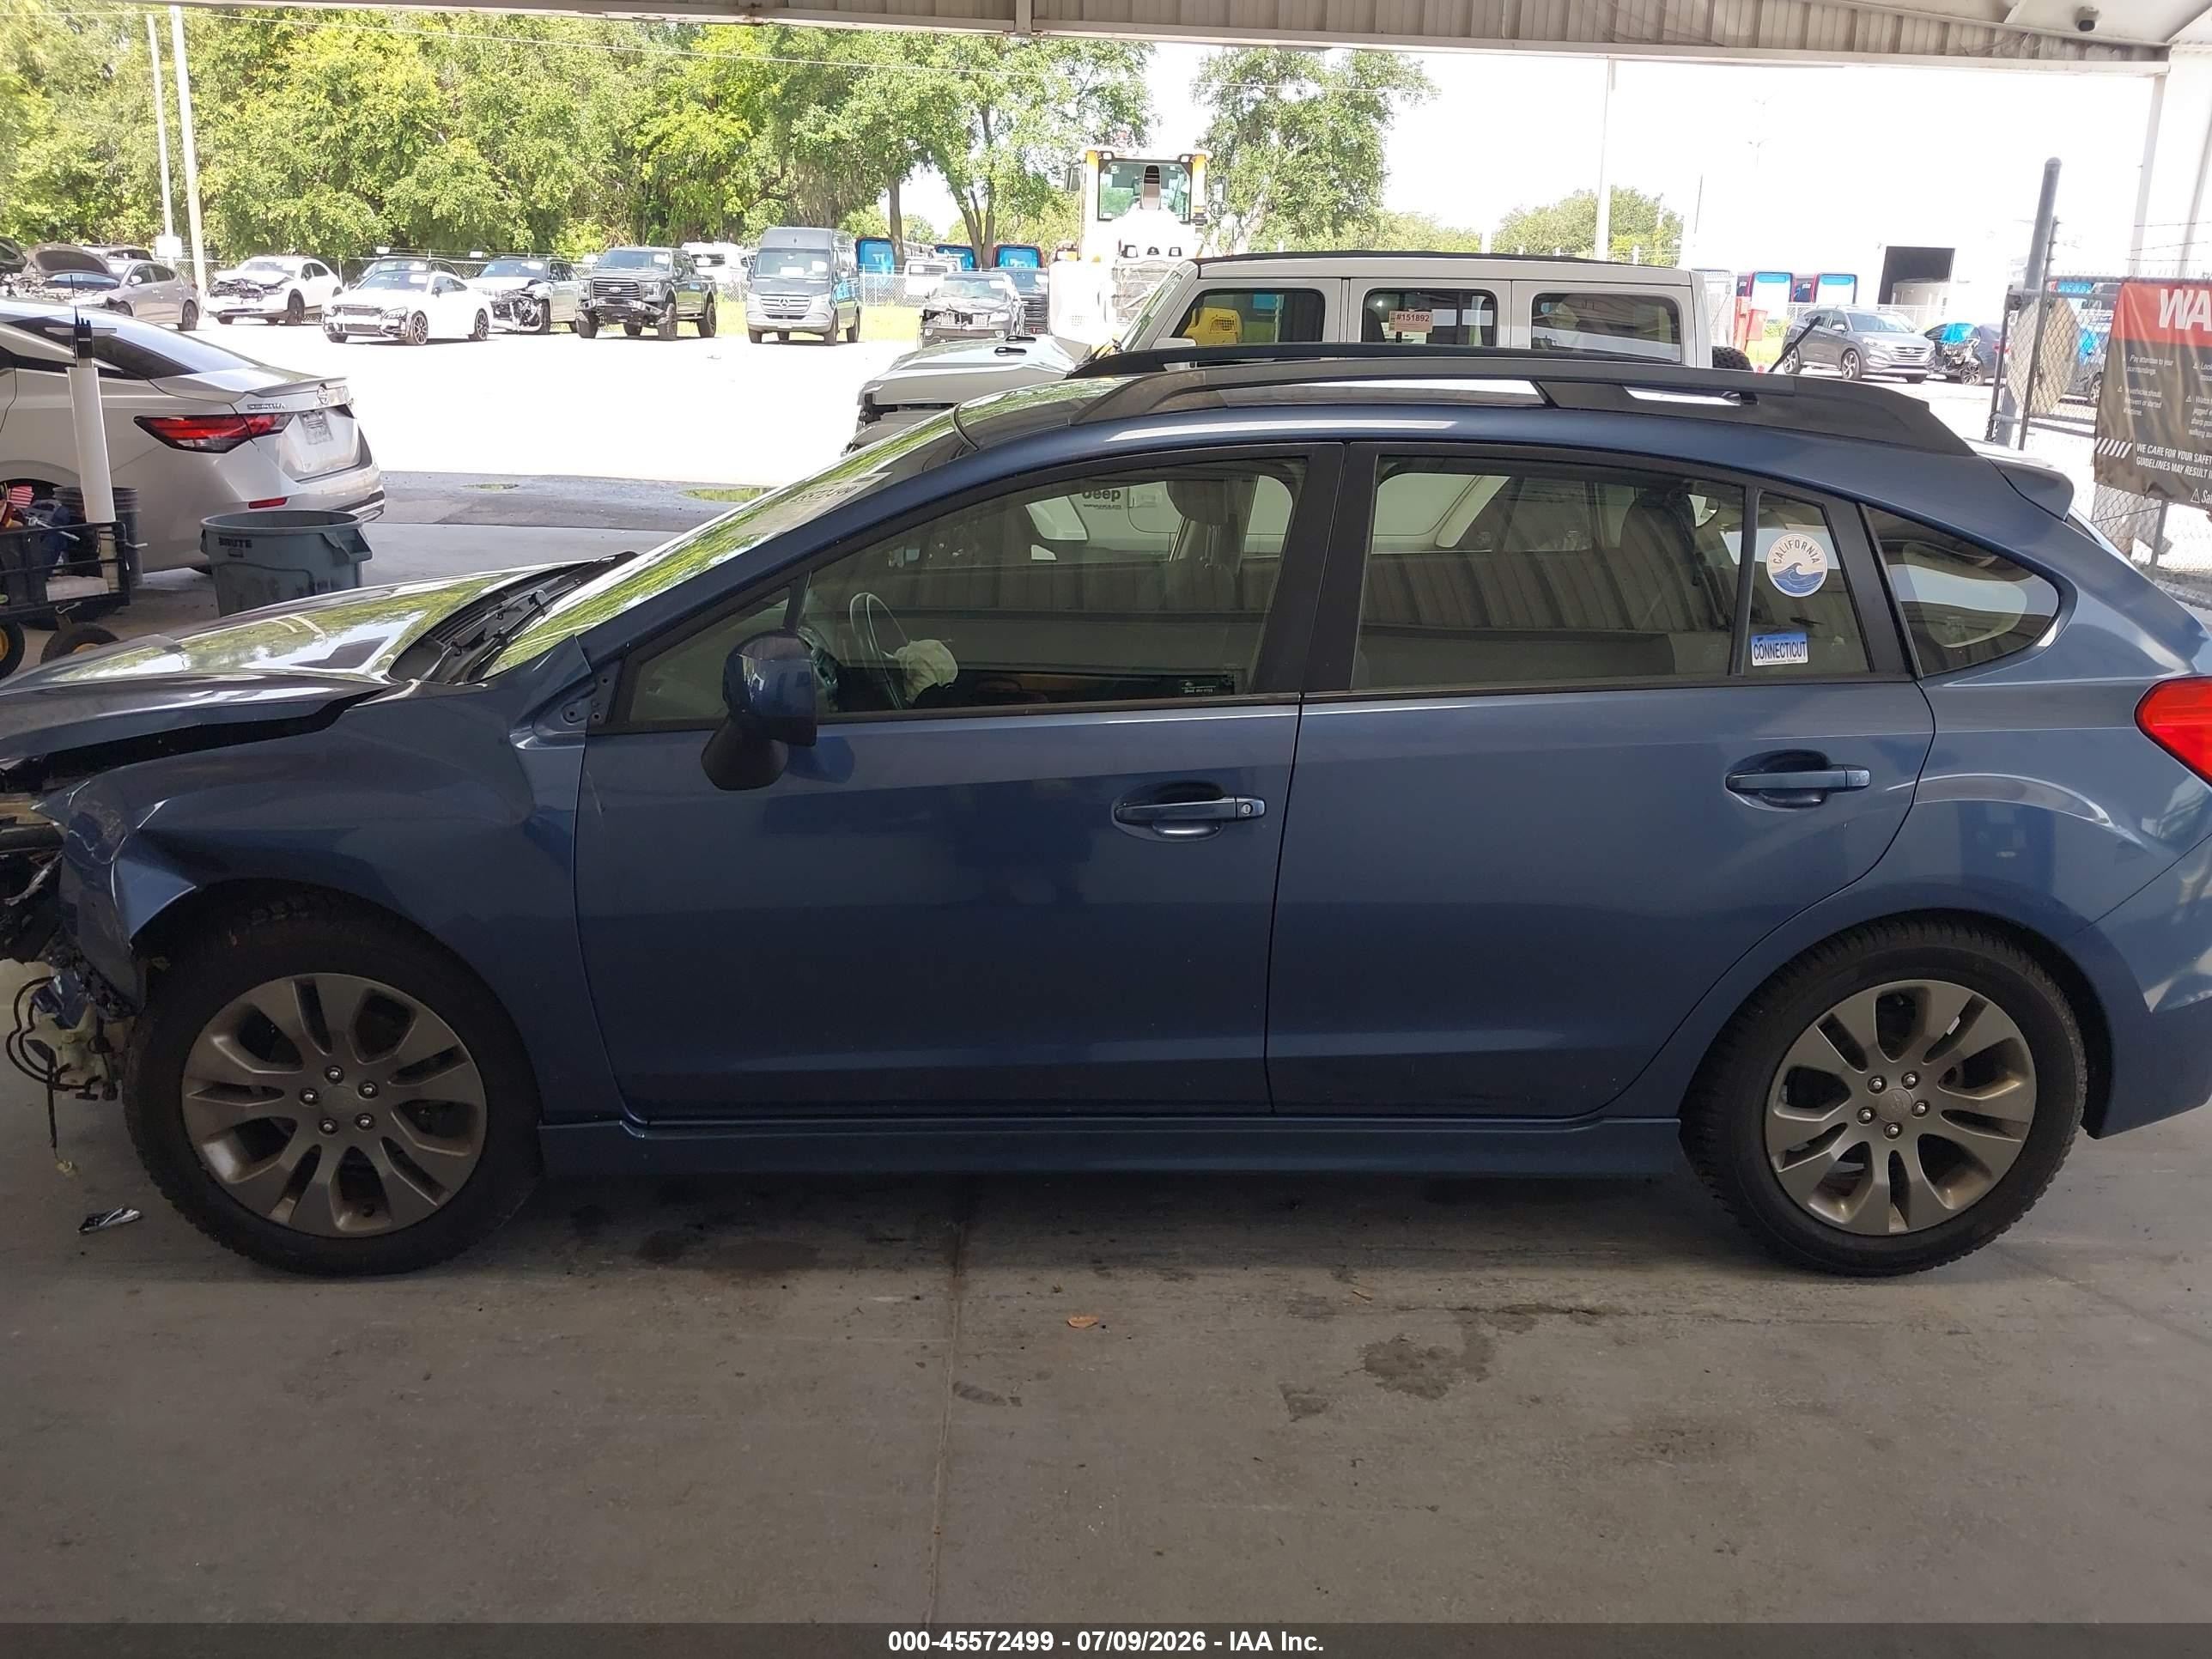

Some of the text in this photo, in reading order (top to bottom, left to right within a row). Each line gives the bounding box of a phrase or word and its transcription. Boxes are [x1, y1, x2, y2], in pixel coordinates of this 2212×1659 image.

[1396, 313, 1430, 322] #151892
[2159, 289, 2212, 331] WA
[2136, 443, 2148, 453] WE
[2148, 445, 2164, 457] CARE
[2165, 448, 2177, 459] FOR
[2178, 450, 2193, 461] YOUR
[2136, 457, 2171, 471] GUIDELINES
[2171, 463, 2185, 474] MAY
[2185, 465, 2208, 478] RESULT
[1773, 539, 1820, 564] CALIFORNIA
[1753, 641, 1806, 660] CONNECTICUT
